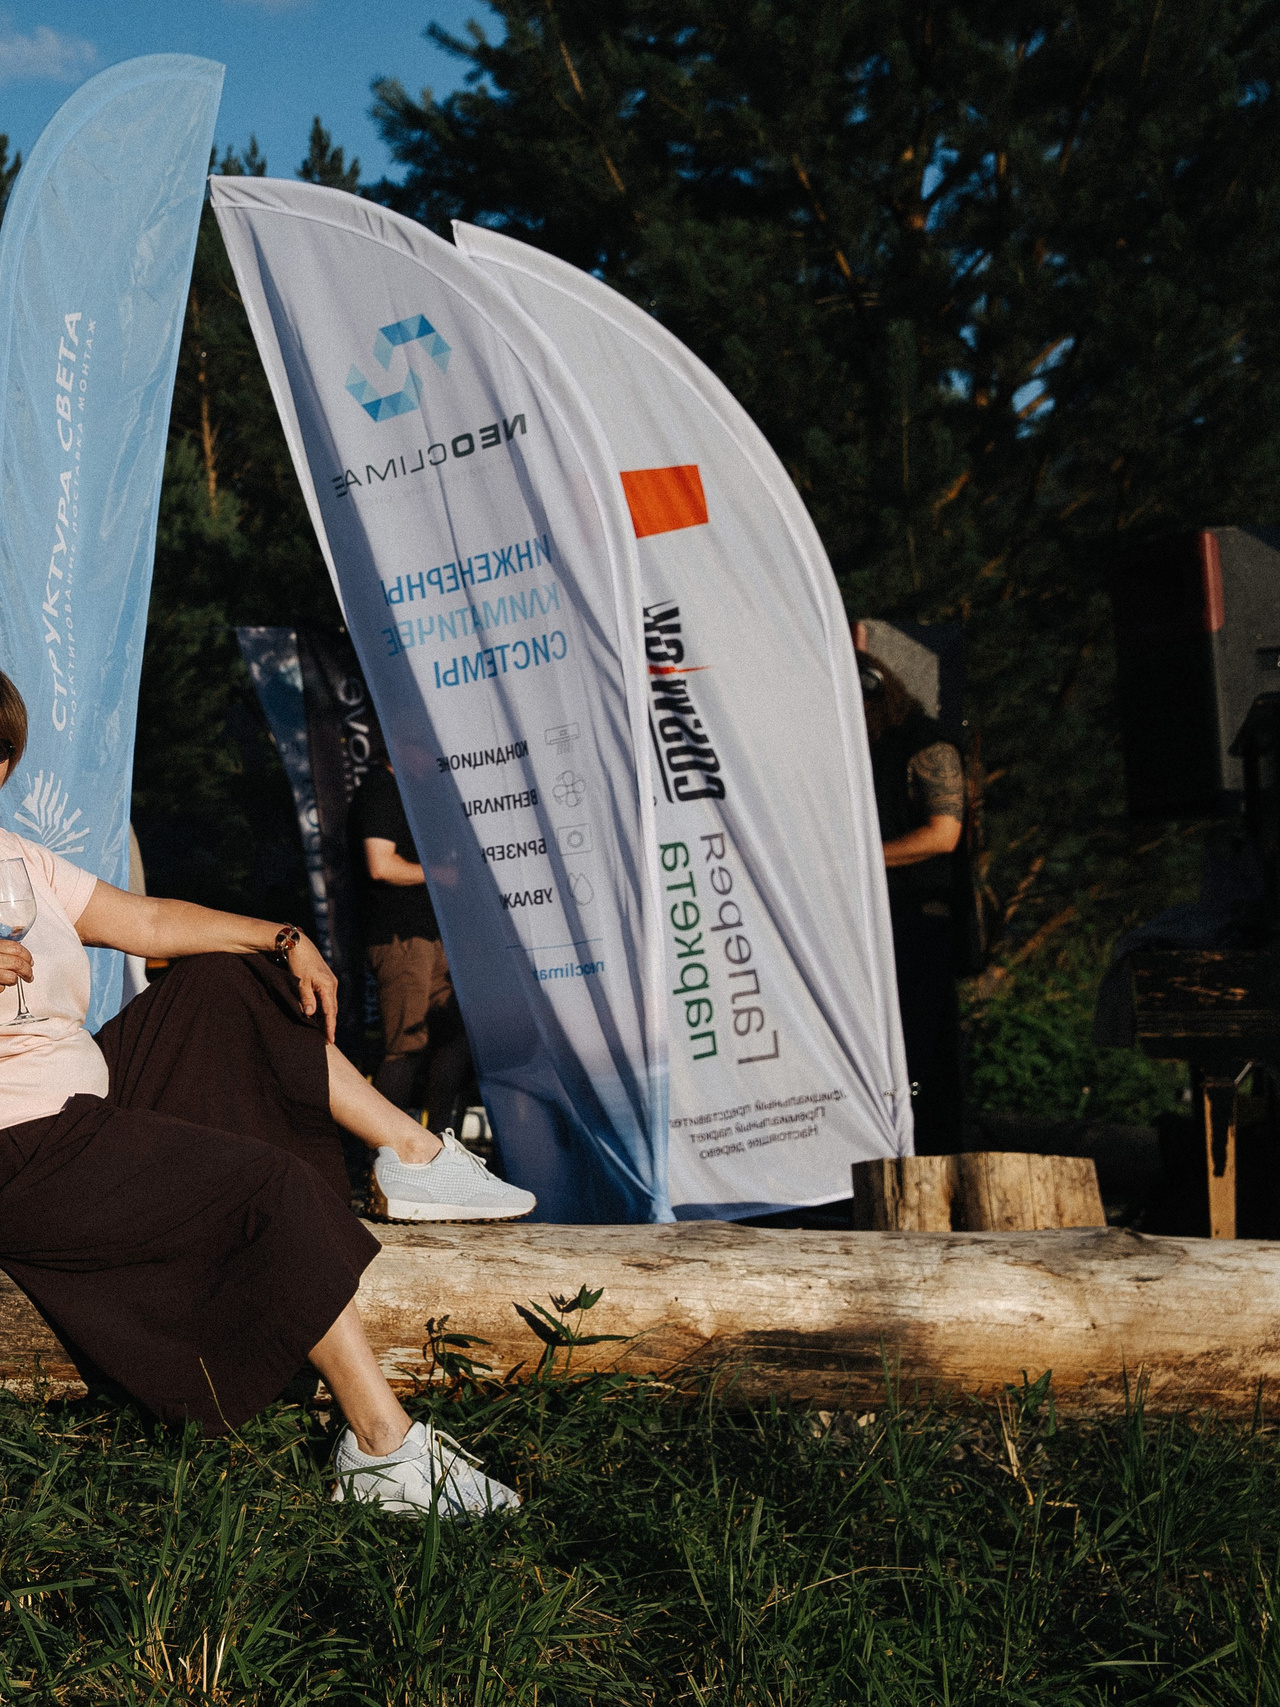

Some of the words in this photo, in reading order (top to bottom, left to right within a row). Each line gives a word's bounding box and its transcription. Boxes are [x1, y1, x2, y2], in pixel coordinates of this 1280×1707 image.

[56, 312, 82, 452] СВЕТА
[77, 317, 96, 411] МОНТАЖ
[72, 422, 83, 533] ПОСТАВКА
[42, 470, 72, 732] СТРУКТУРА
